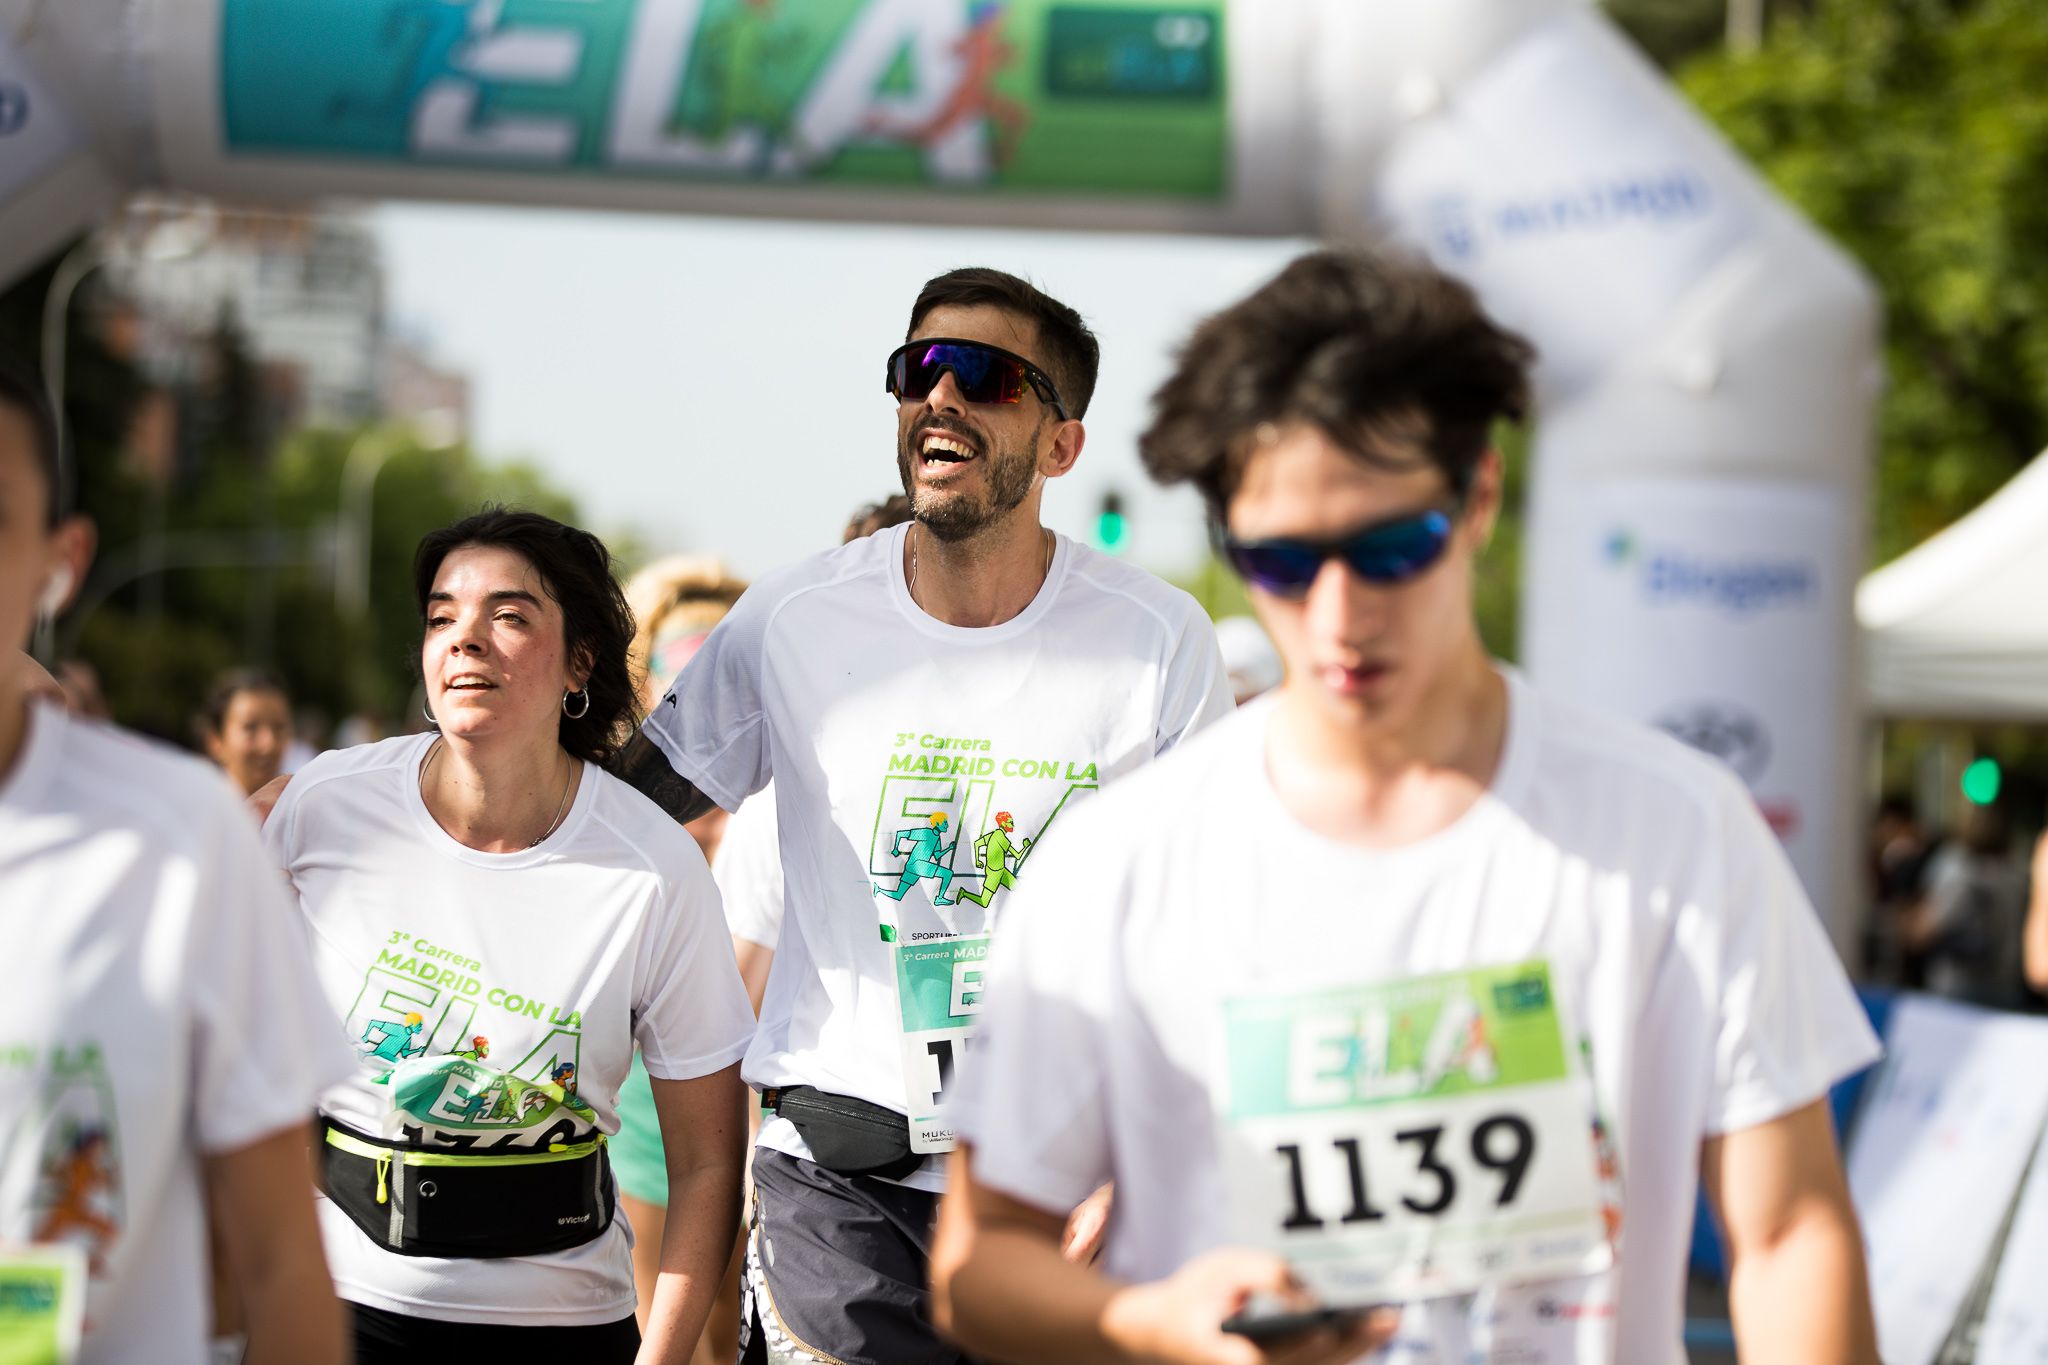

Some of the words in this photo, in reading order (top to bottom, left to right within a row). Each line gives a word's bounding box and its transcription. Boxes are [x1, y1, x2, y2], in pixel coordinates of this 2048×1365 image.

[408, 0, 998, 183] ELA
[888, 754, 995, 776] MADRID
[1001, 758, 1060, 779] CON
[1064, 761, 1098, 781] LA
[919, 733, 991, 752] Carrera
[414, 939, 482, 972] Carrera
[915, 951, 950, 961] Carrera
[953, 946, 987, 959] MAD
[377, 948, 482, 996] MADRID
[487, 988, 545, 1020] CON
[548, 1007, 581, 1029] LA
[1287, 995, 1499, 1107] ELA
[1276, 1113, 1537, 1233] 1139
